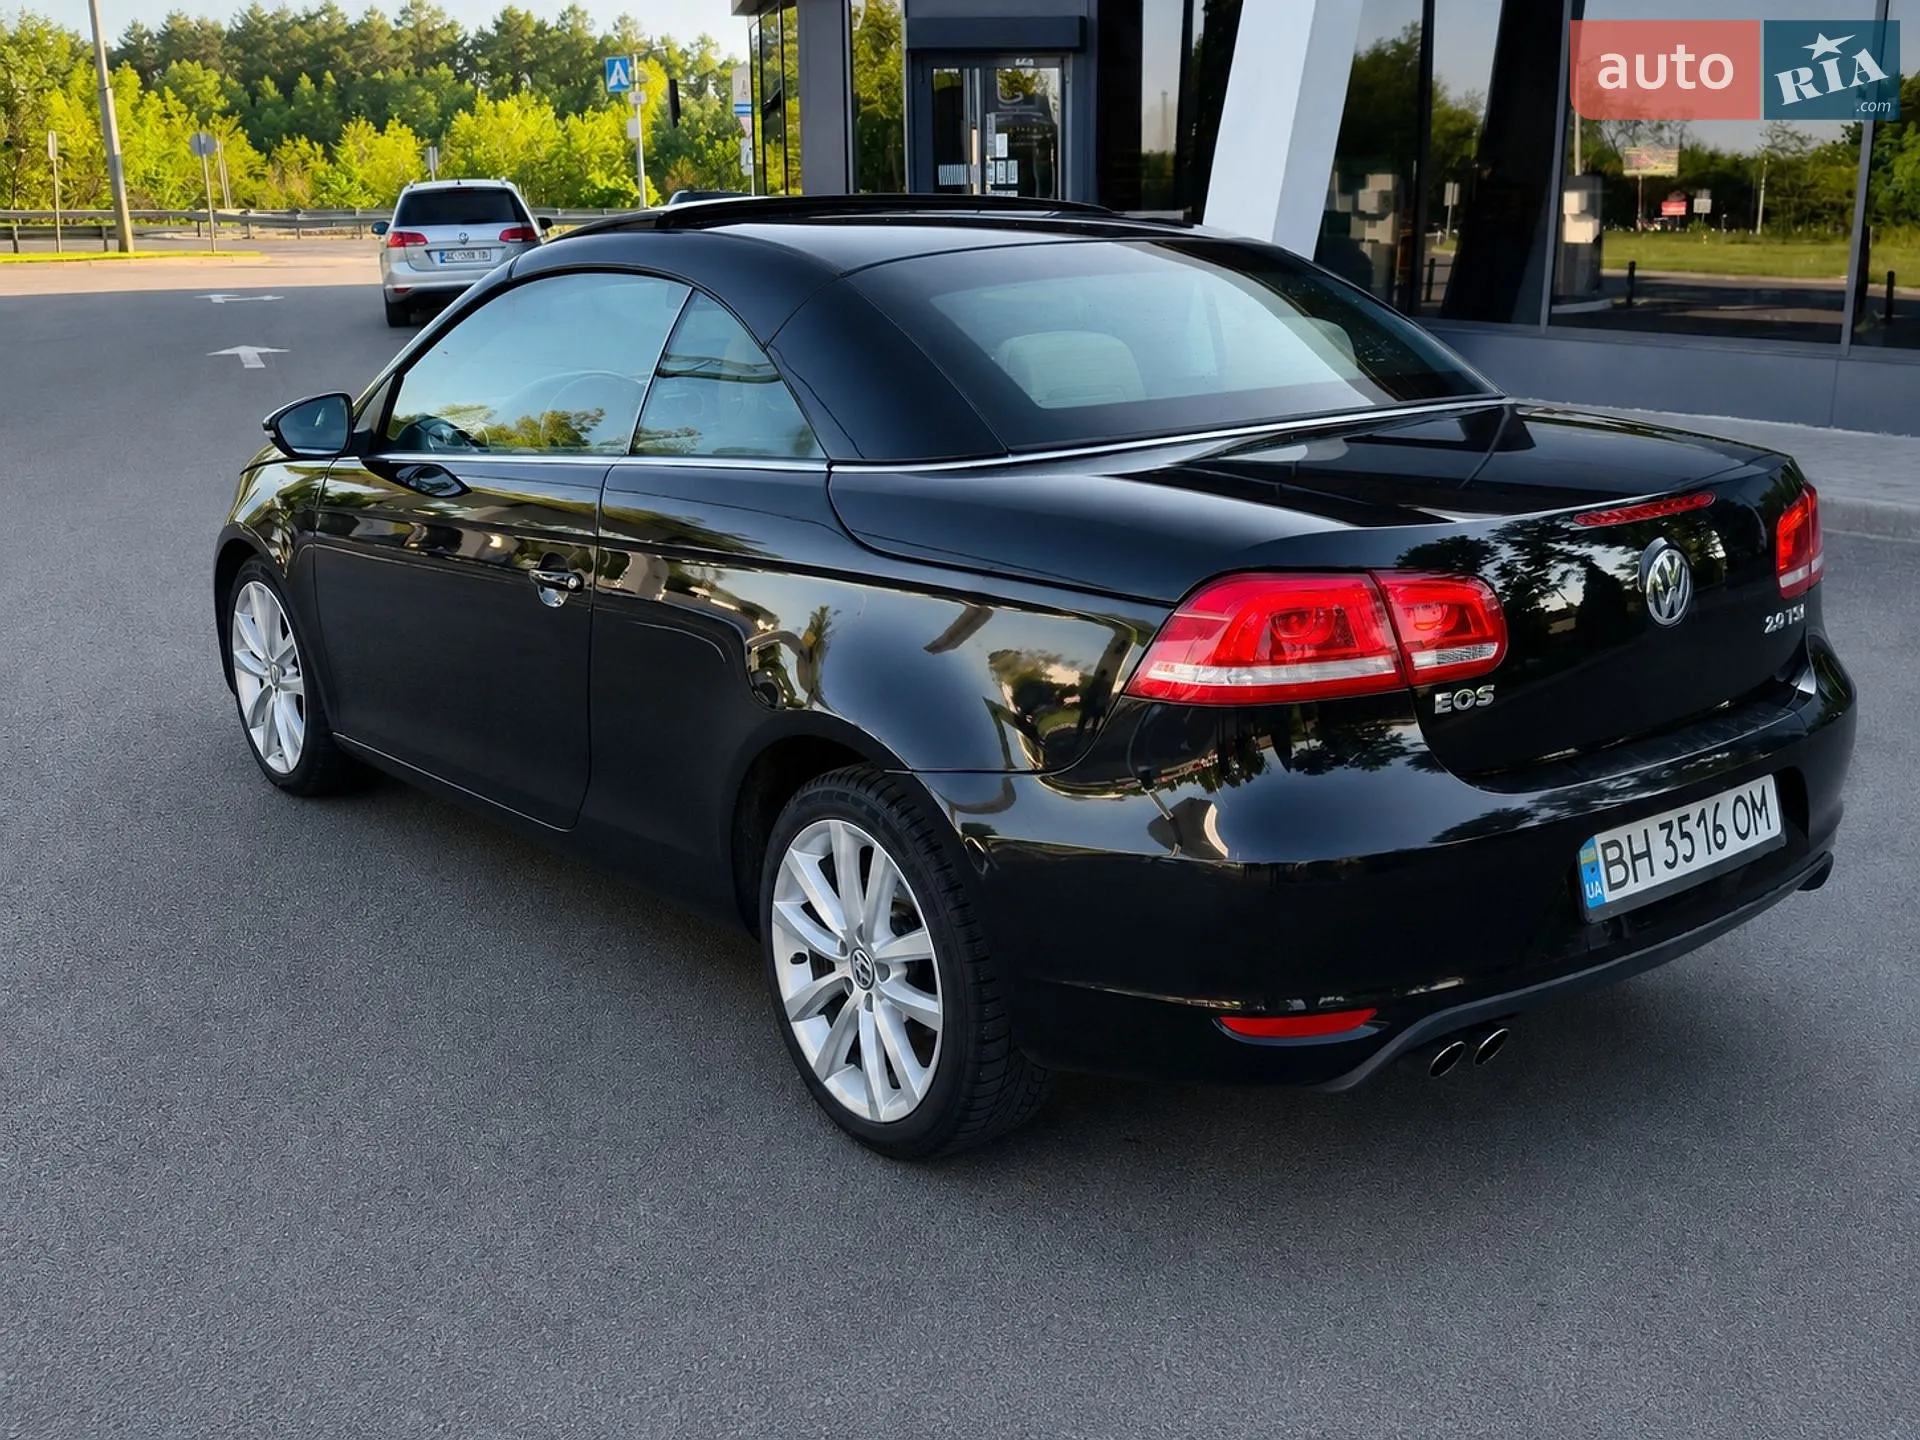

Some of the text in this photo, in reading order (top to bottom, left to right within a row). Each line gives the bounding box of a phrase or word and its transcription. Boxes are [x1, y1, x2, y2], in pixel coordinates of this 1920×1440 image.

[1434, 684, 1495, 714] EOS
[1601, 784, 1772, 892] BH 3516 OM
[1585, 880, 1604, 899] UA
